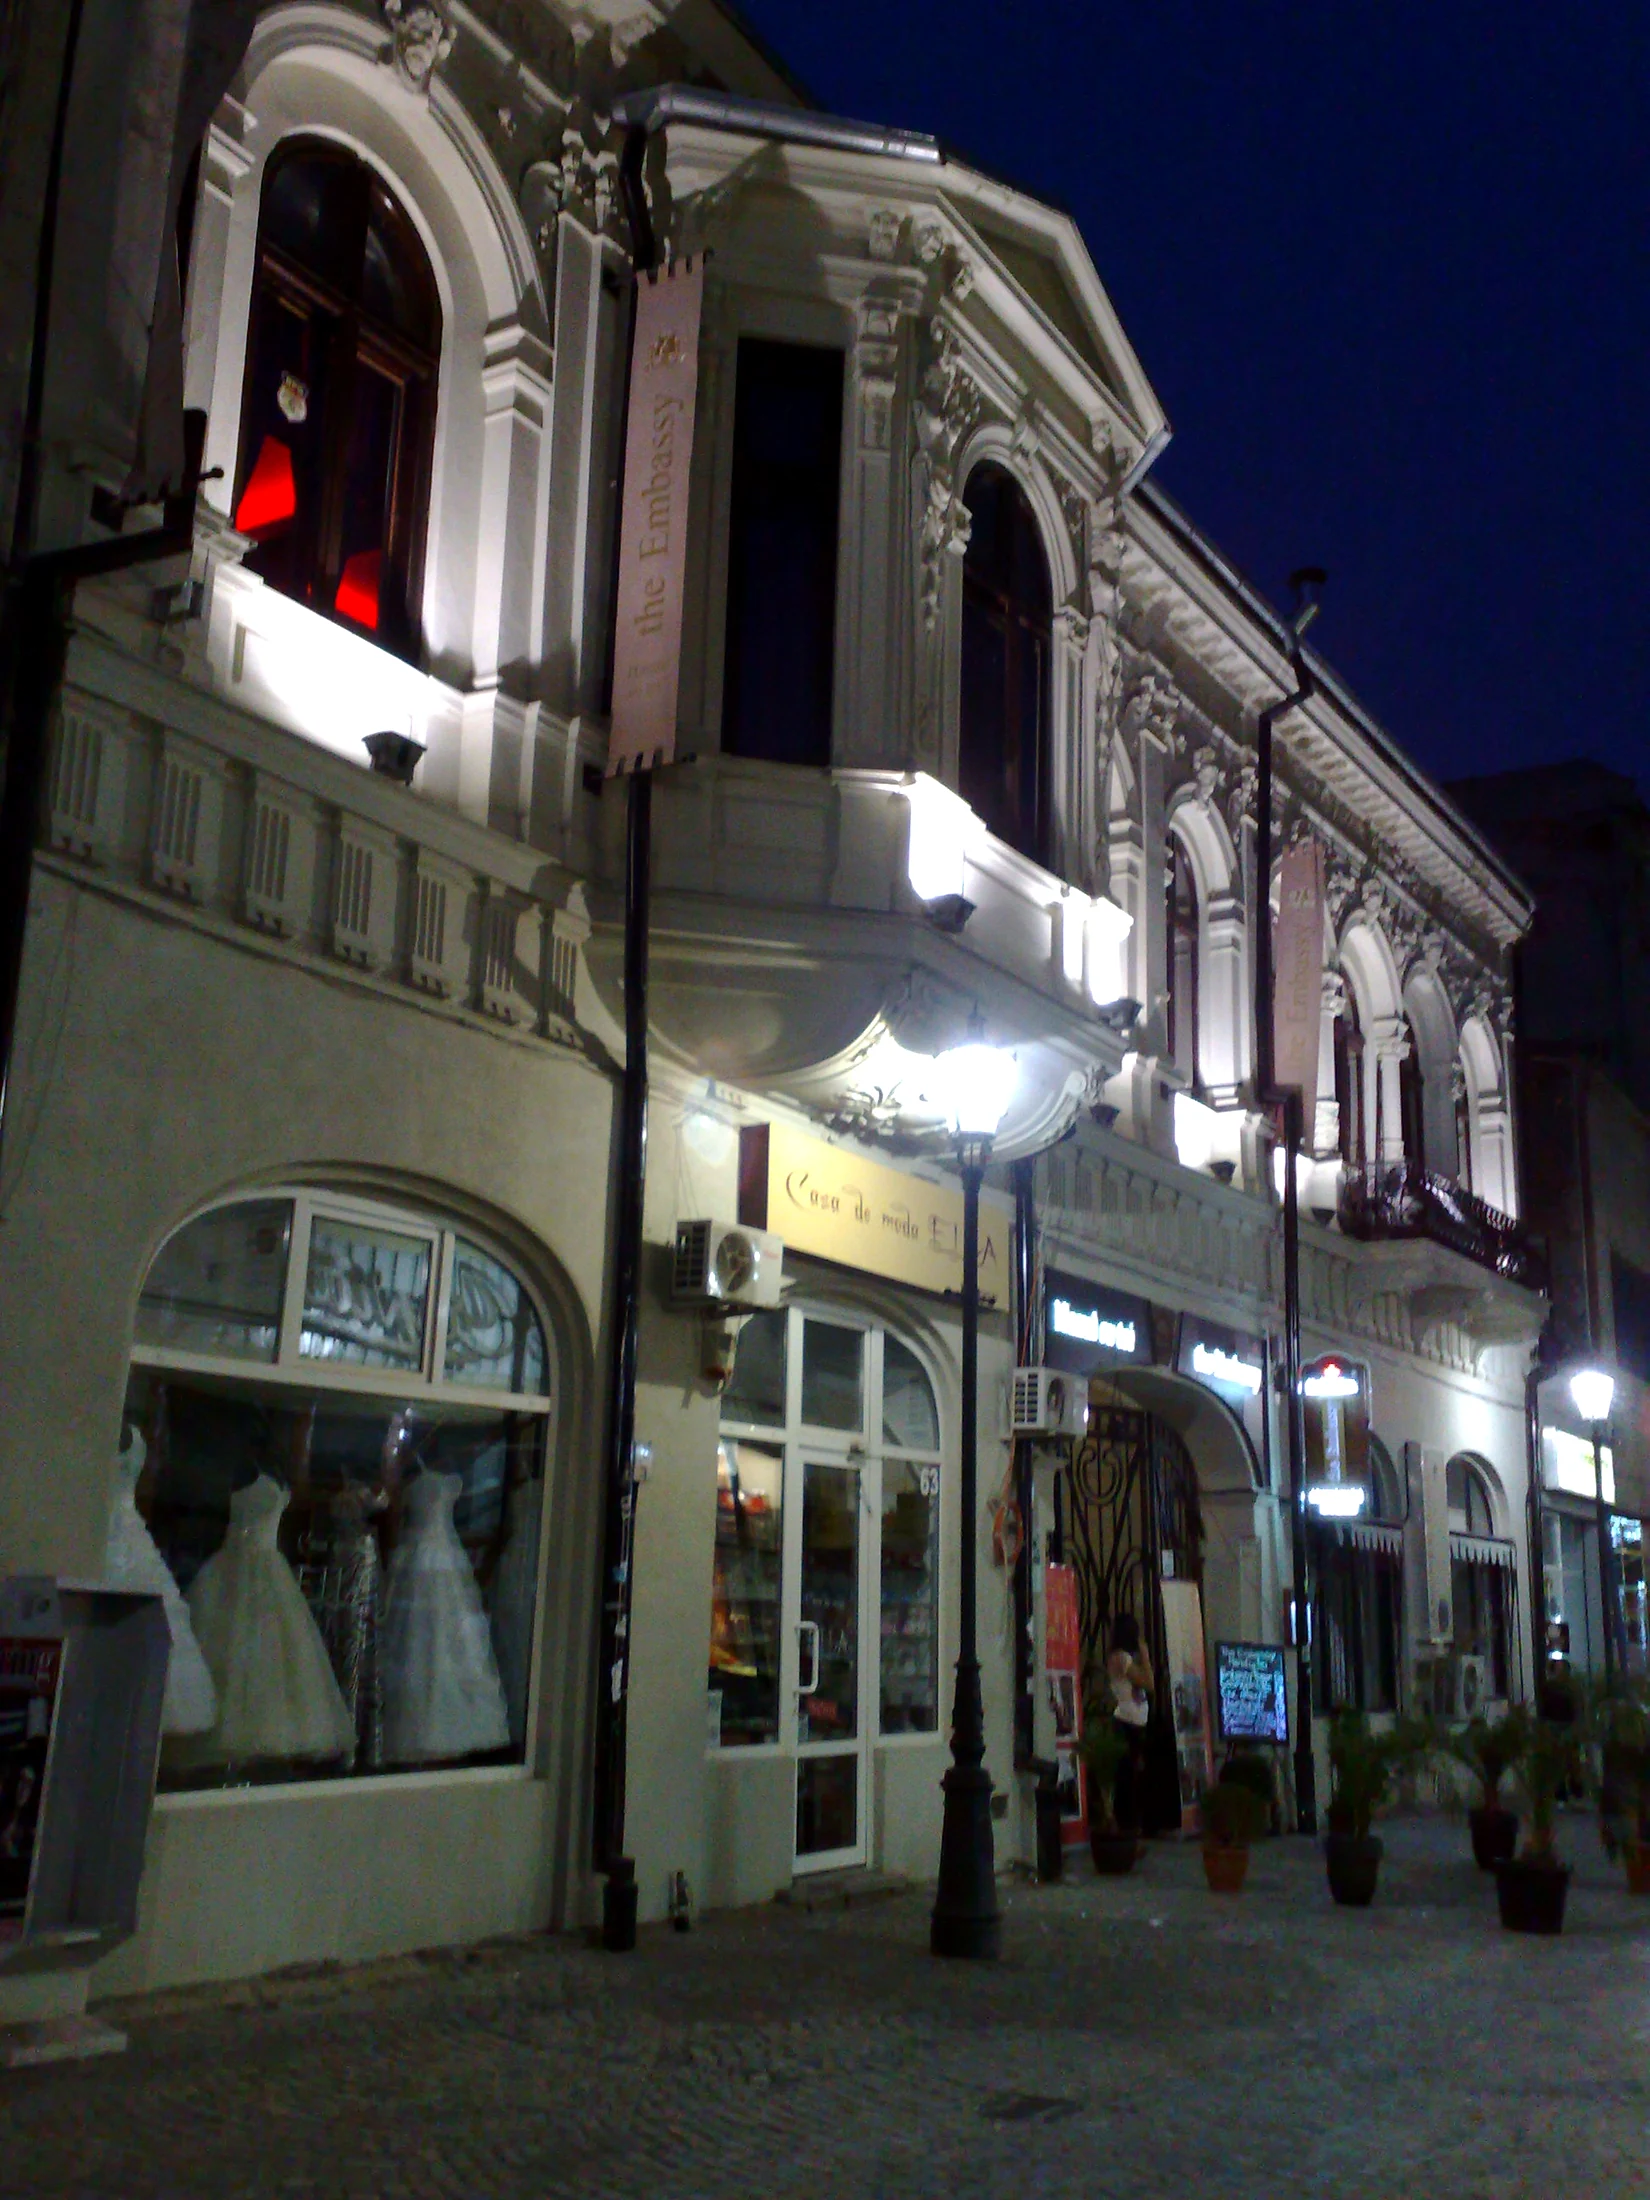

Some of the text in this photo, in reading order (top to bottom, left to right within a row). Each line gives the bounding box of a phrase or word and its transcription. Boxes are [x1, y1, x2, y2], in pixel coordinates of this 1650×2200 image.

[633, 393, 684, 637] the Embassy
[786, 1171, 840, 1215] Casa
[842, 1183, 871, 1225] de
[881, 1203, 919, 1240] moda
